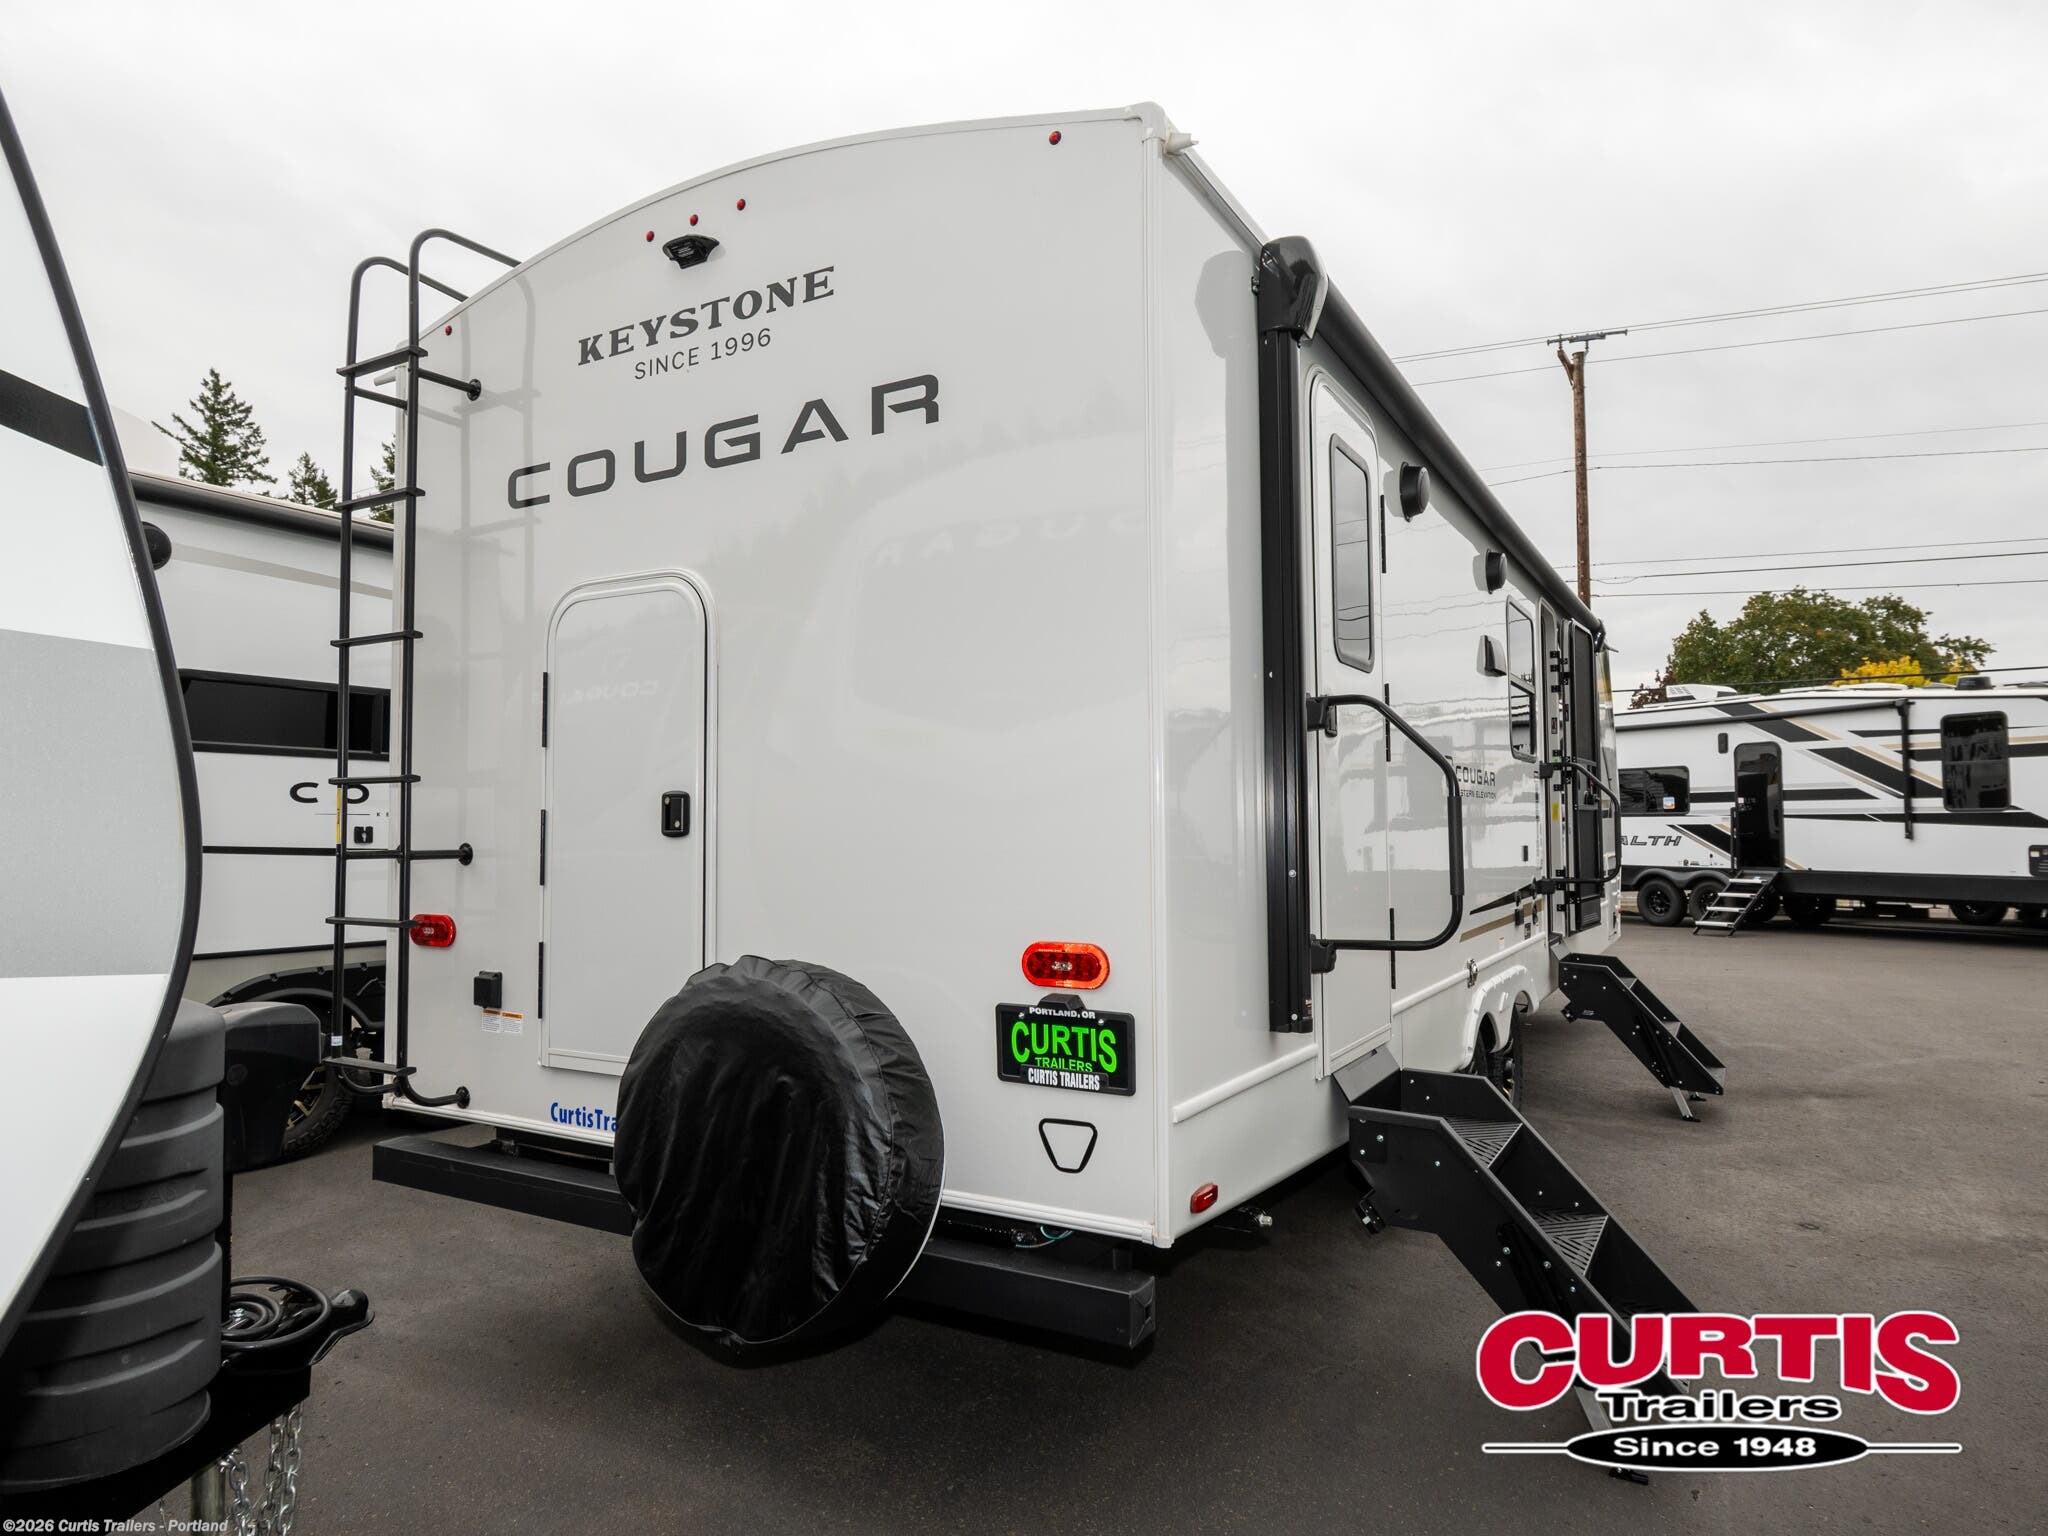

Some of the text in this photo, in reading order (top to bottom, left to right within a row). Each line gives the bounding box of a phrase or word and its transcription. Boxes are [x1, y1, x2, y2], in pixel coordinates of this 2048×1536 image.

[578, 266, 834, 365] KEYSTONE
[634, 328, 772, 380] SINCE 1996
[508, 374, 939, 509] COUGAR
[1456, 765, 1496, 787] COUGAR
[1619, 835, 1682, 847] ALTH
[1081, 1011, 1096, 1020] OR
[1011, 1021, 1118, 1073] CURTIS
[1034, 1056, 1093, 1073] TRAILERS
[1028, 1067, 1100, 1091] CURTIS TRAILERS
[550, 1102, 617, 1132] CurtisTra
